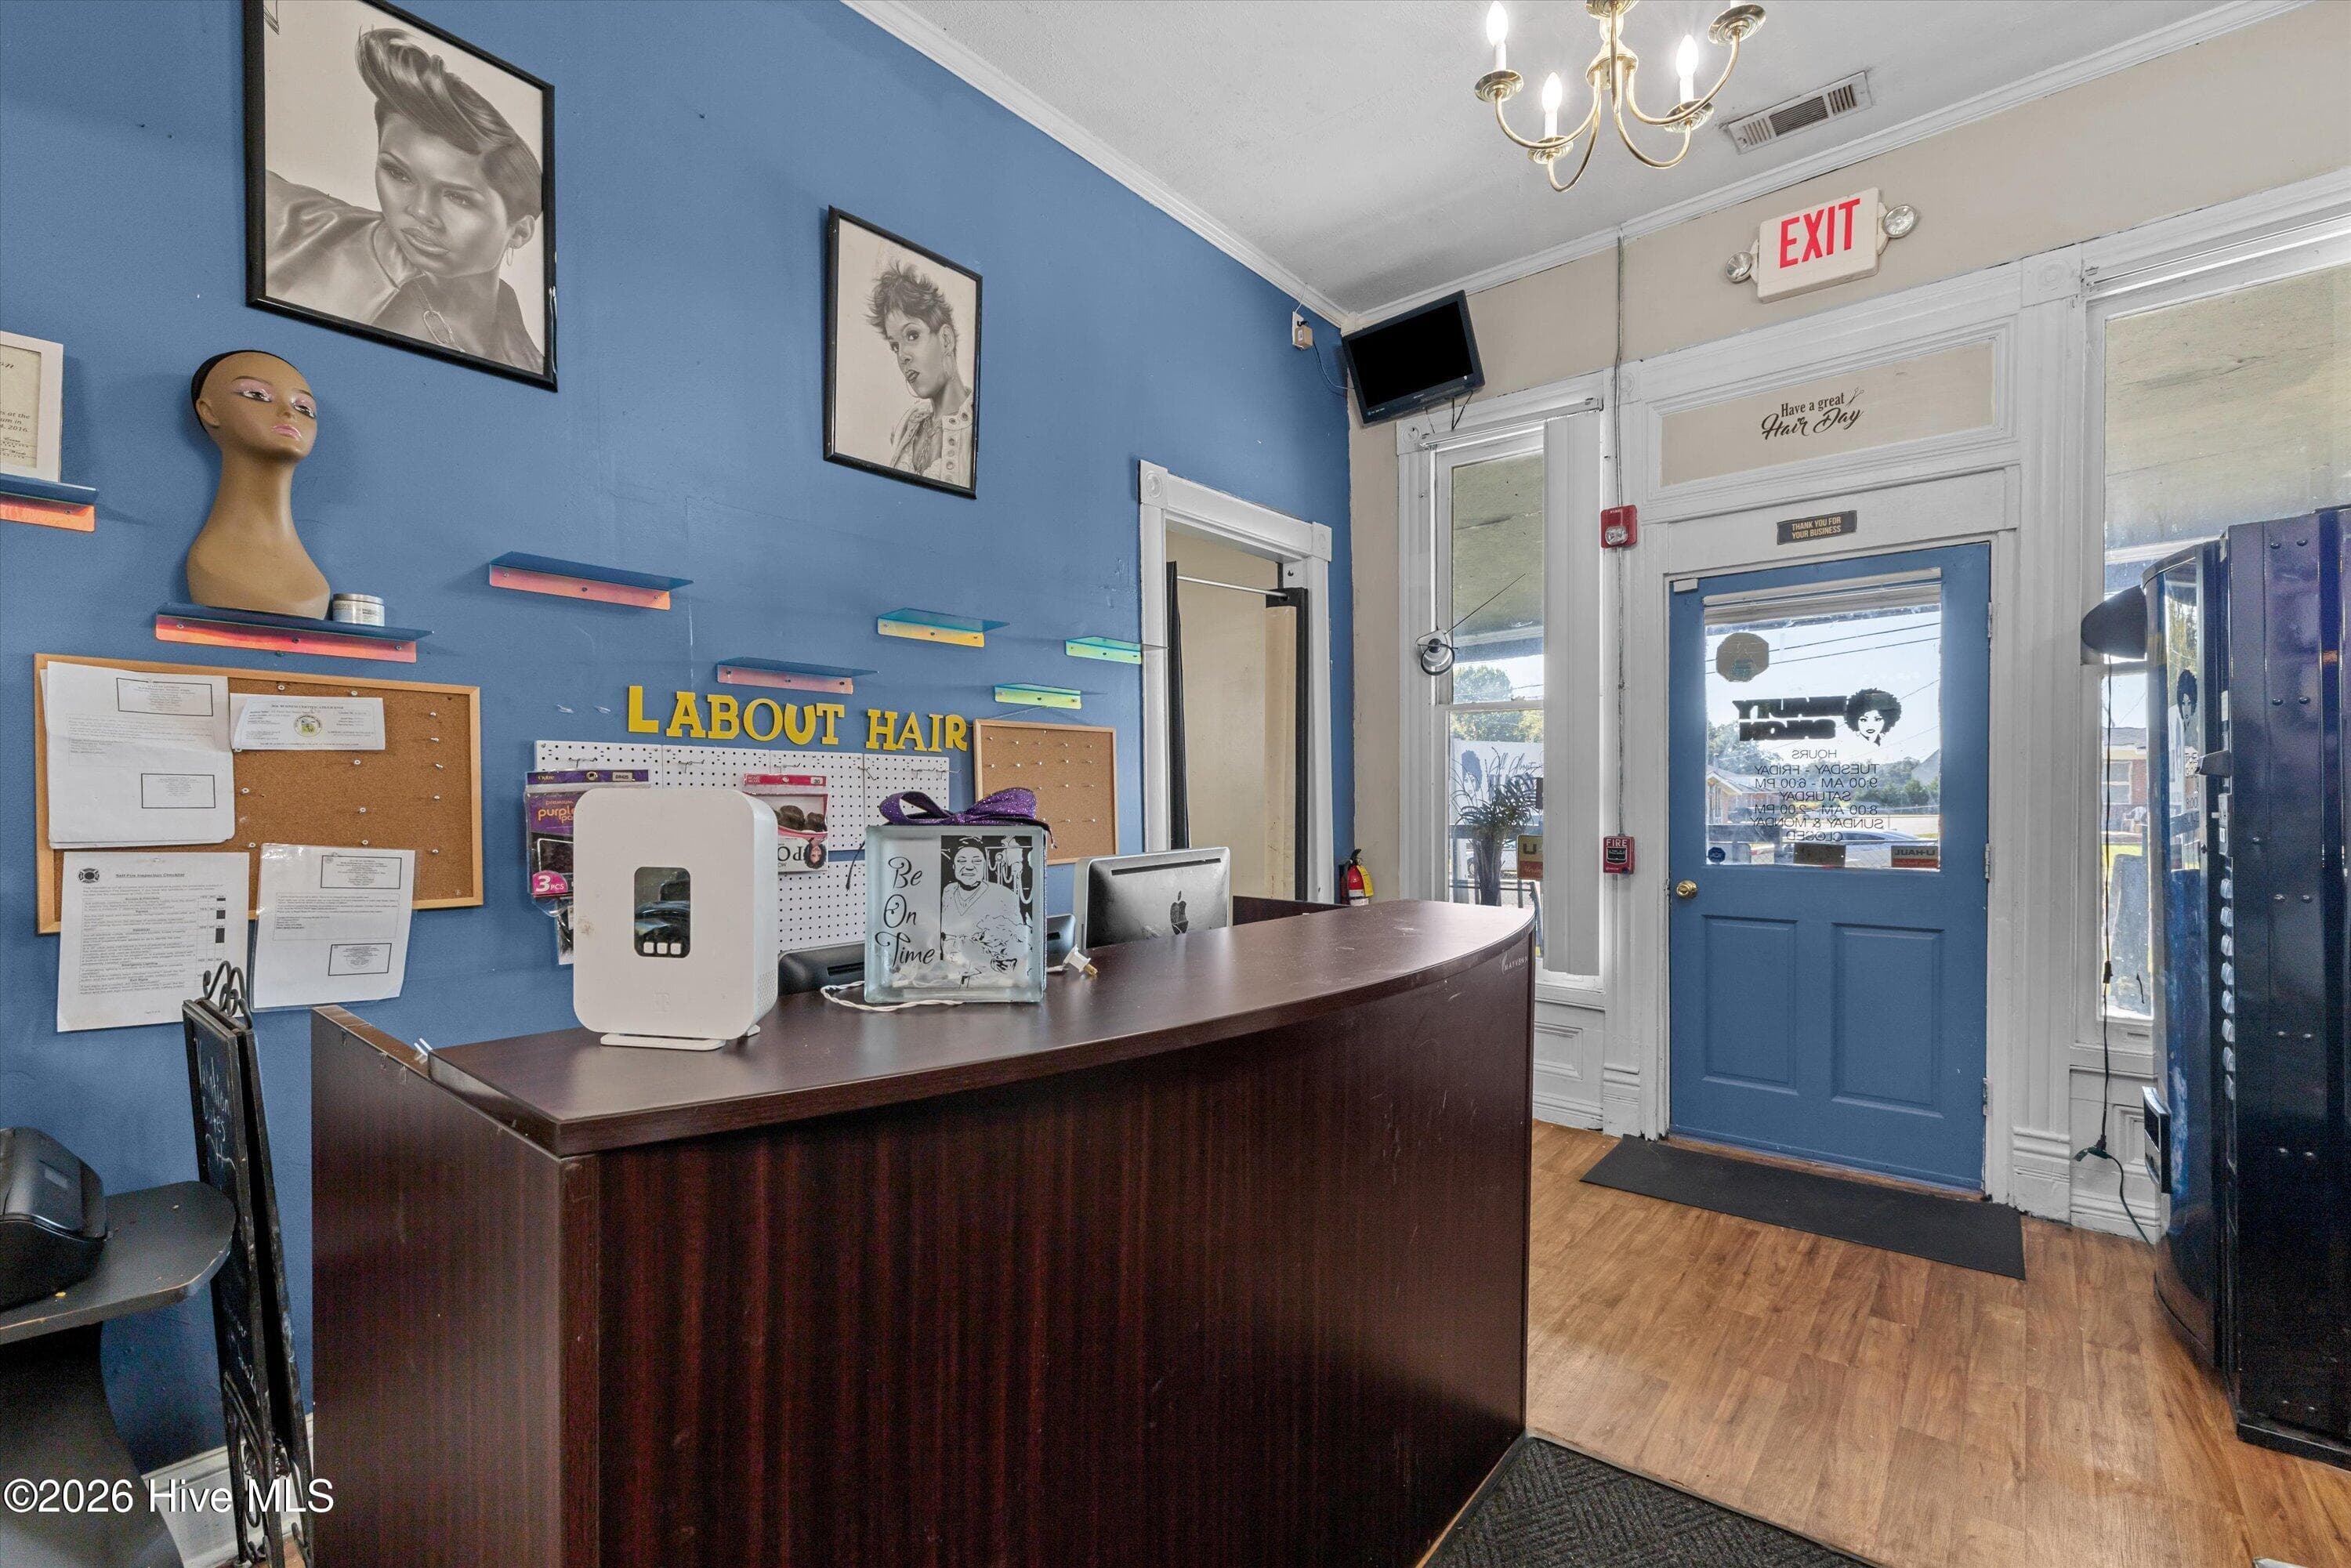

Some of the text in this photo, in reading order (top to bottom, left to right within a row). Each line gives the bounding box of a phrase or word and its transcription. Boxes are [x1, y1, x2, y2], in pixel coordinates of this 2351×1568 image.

[1778, 197, 1860, 270] EXIT
[1780, 393, 1845, 418] Have a great
[1761, 407, 1864, 440] Hair Day
[1791, 516, 1842, 531] THANK YOU FOR
[1792, 525, 1842, 539] YOUR BUSINESS
[865, 708, 968, 752] HAIR
[535, 875, 551, 893] 3
[888, 856, 923, 889] Be
[883, 894, 917, 928] On
[875, 931, 935, 968] Time
